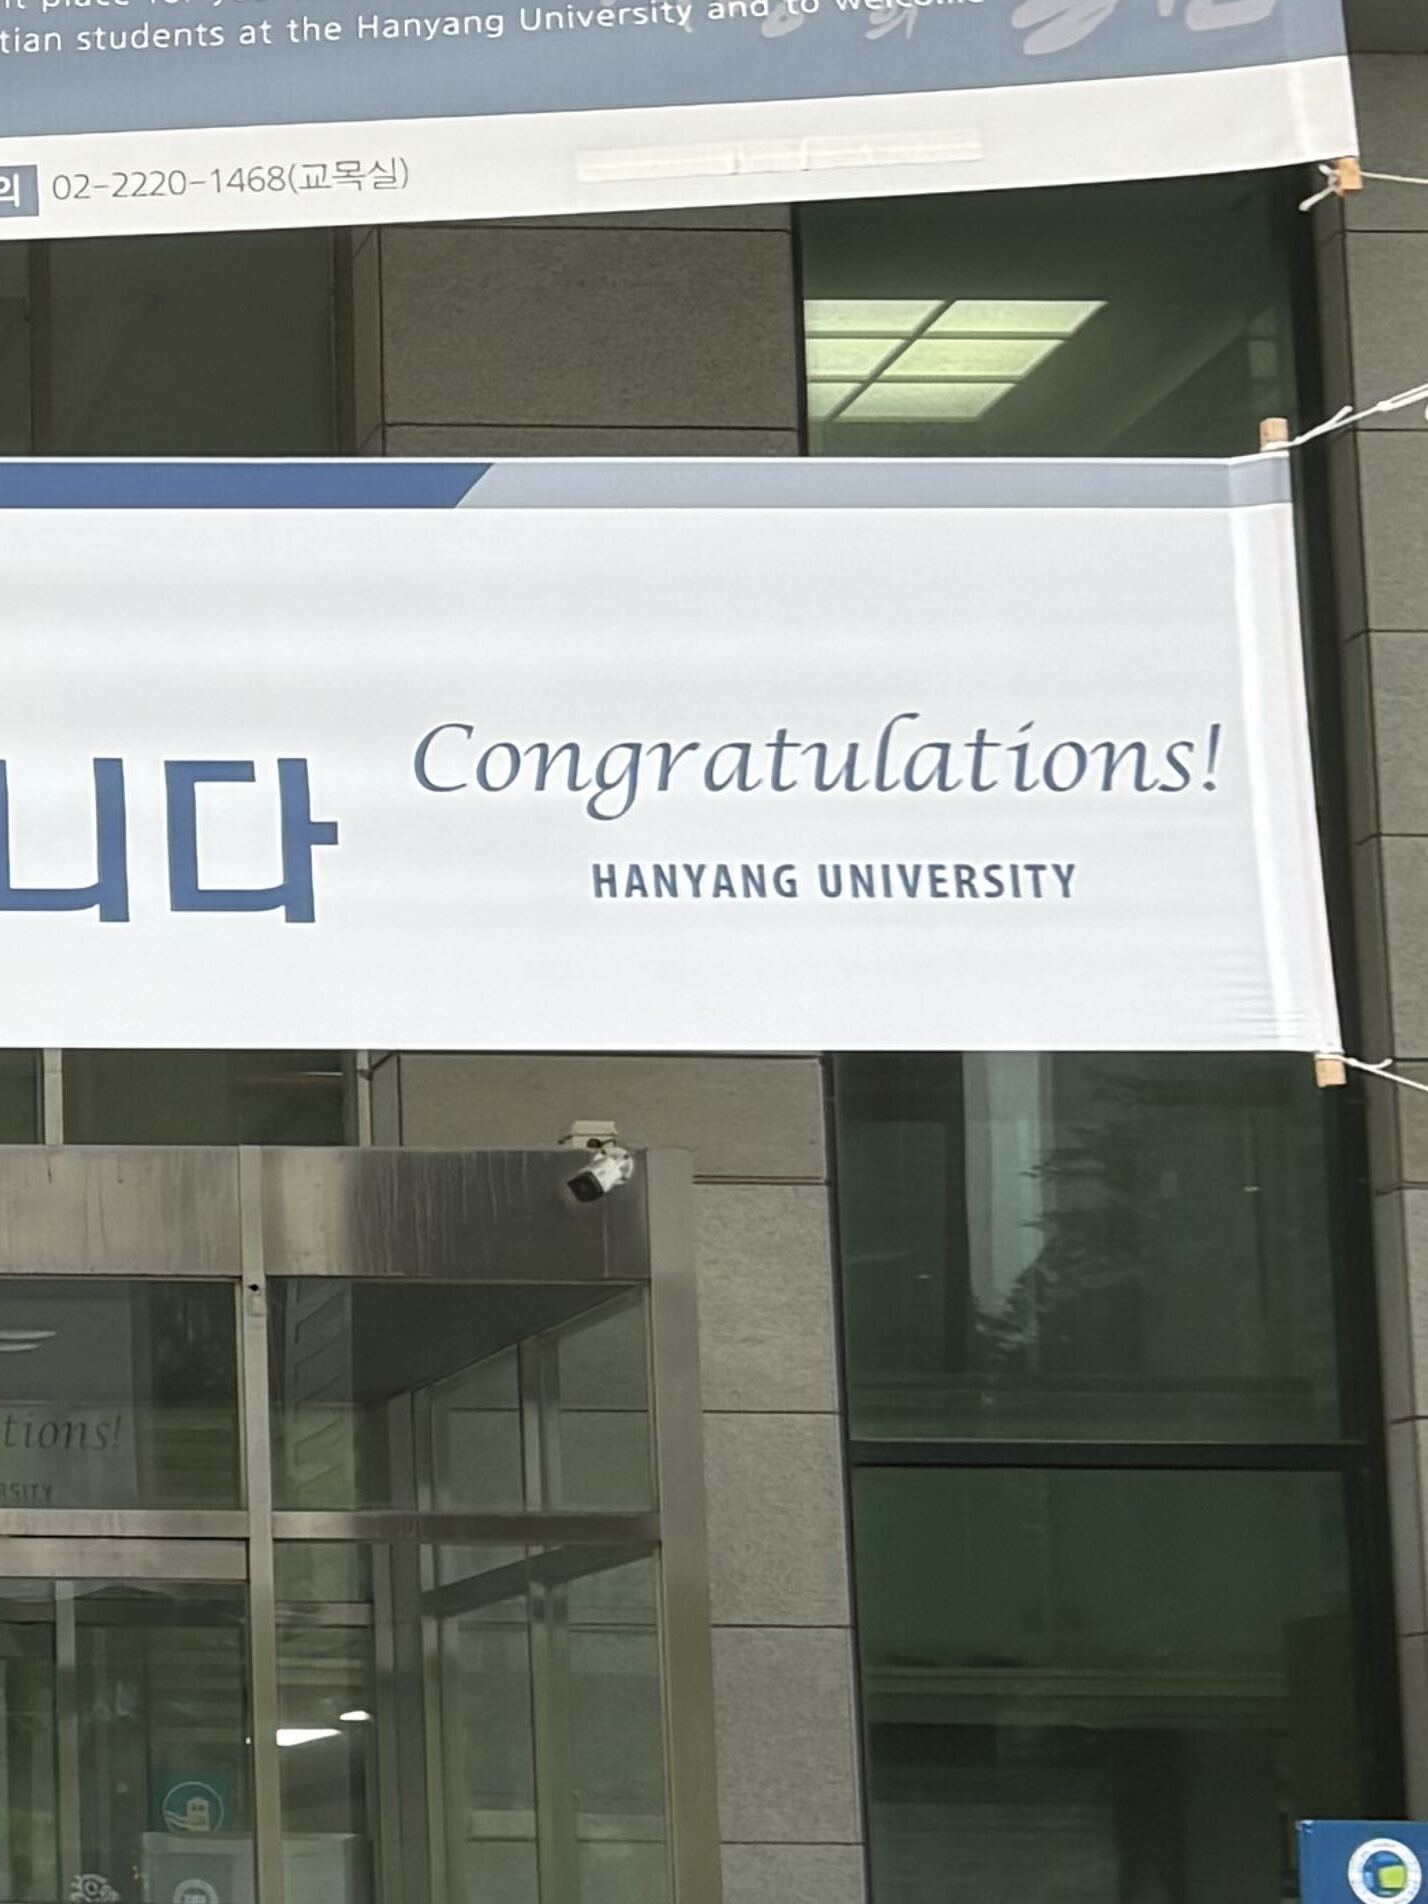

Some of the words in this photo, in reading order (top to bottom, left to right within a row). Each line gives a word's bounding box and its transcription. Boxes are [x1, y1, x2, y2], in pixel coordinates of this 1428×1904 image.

[77, 21, 225, 51] students
[239, 20, 272, 45] at
[286, 15, 342, 43] the
[358, 14, 504, 41] Hanyang
[520, 0, 692, 33] University
[52, 157, 409, 201] 02-2220-1468(교목실)
[413, 712, 1221, 821] Congratulations!
[592, 863, 798, 899] HANYANG
[818, 863, 1076, 899] UNIVERSITY
